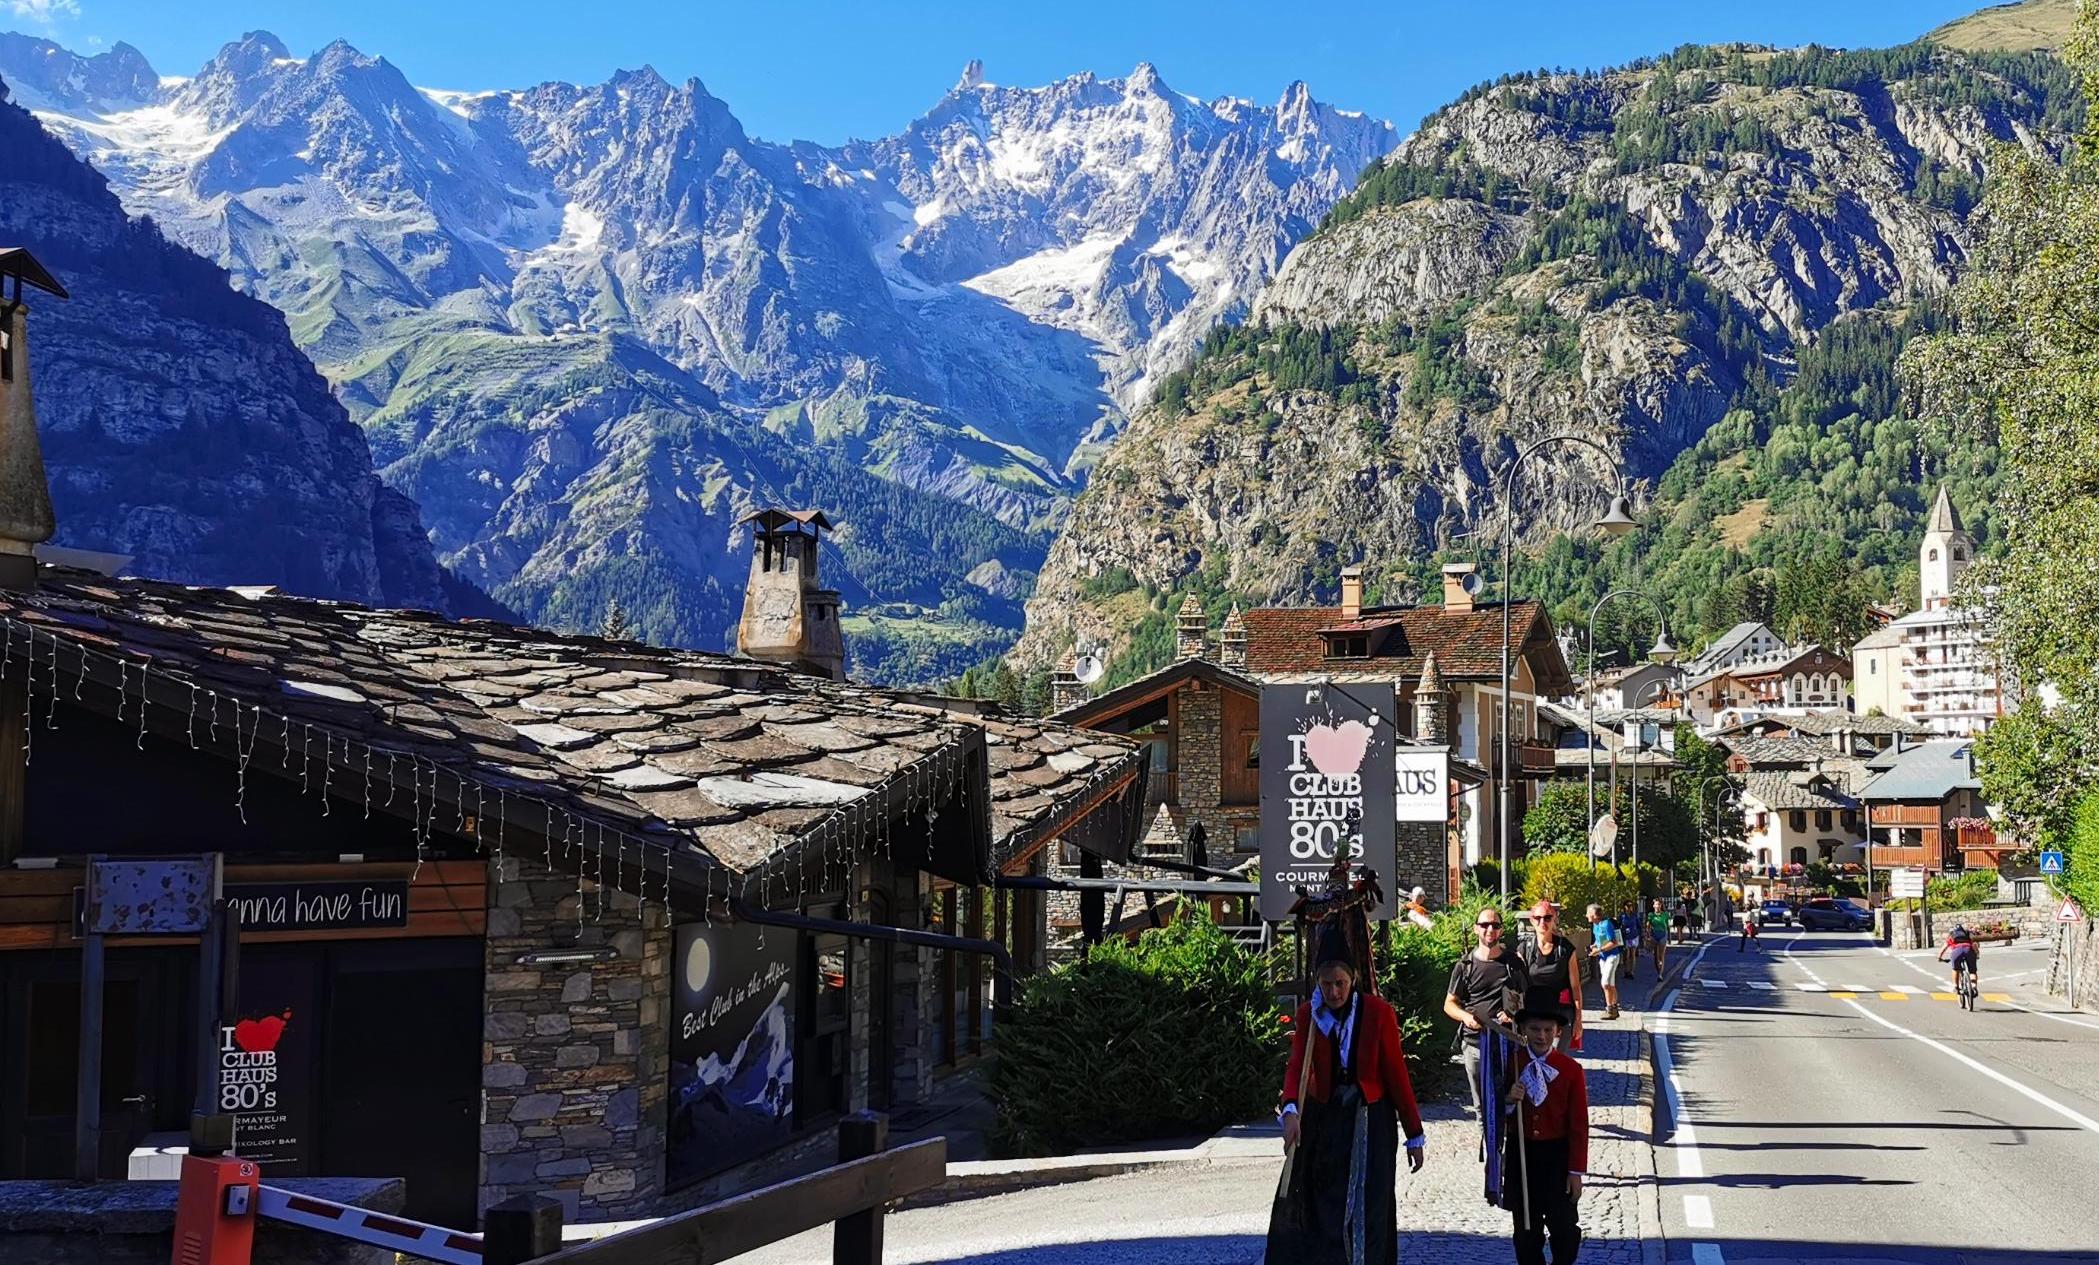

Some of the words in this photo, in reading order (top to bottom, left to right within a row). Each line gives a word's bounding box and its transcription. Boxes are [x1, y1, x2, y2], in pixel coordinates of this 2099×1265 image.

[1288, 735, 1307, 771] I
[1289, 772, 1362, 796] CLUB
[1288, 796, 1364, 820] HAUS
[1289, 884, 1322, 893] MNT
[296, 889, 351, 923] have
[358, 887, 400, 921] fun
[682, 1008, 707, 1039] Best
[710, 987, 733, 1026] Club
[736, 988, 745, 1006] in
[748, 972, 761, 998] the
[221, 1026, 236, 1051] I
[222, 1050, 277, 1068] CLUB
[220, 1066, 278, 1085] HAUS
[221, 1083, 277, 1110] 80's
[235, 1139, 276, 1147] IXOLOGY
